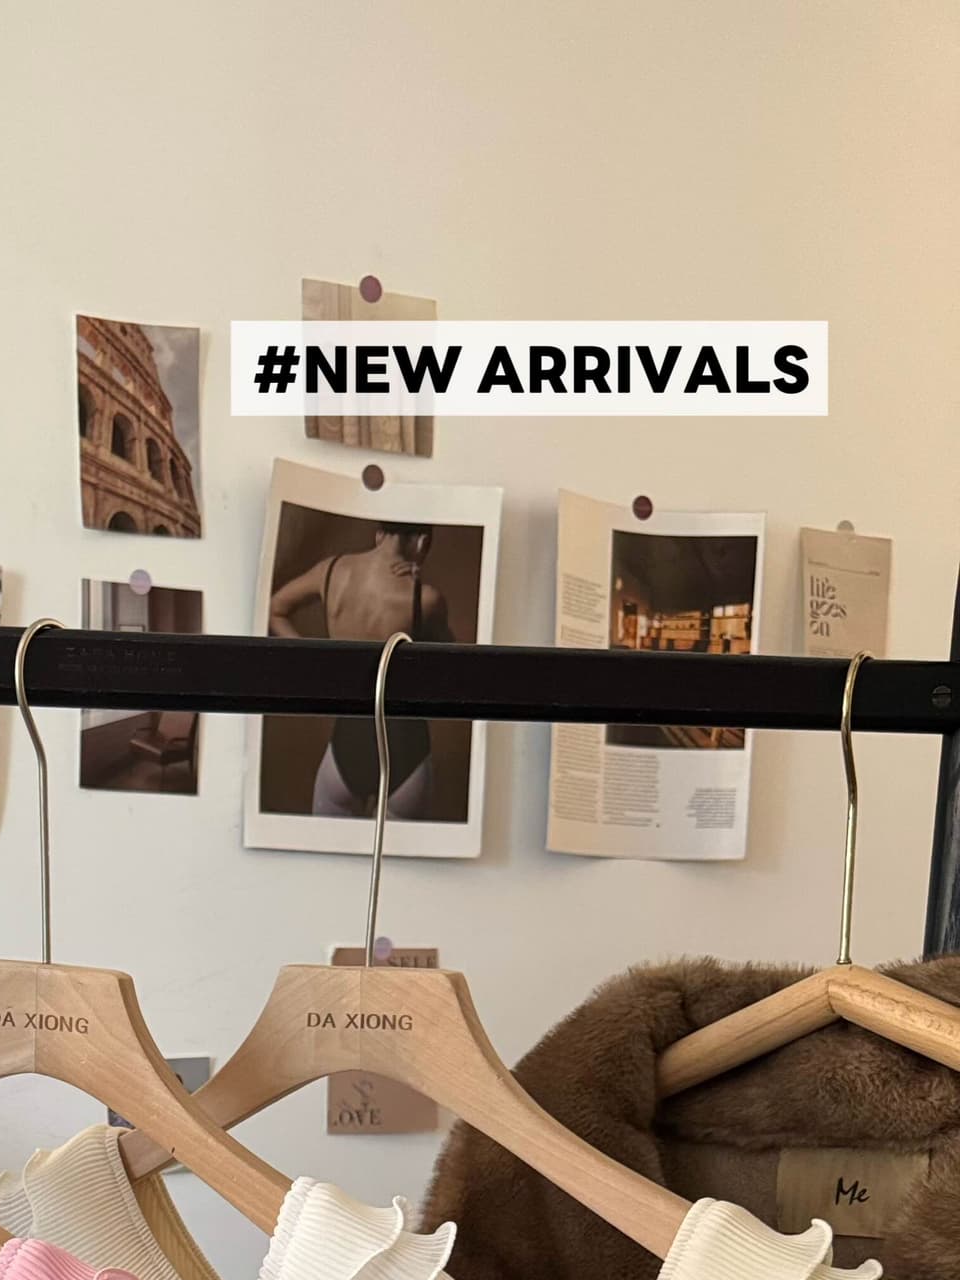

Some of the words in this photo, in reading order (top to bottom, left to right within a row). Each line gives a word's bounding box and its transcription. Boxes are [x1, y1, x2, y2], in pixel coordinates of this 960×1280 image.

[24, 1012, 90, 1035] XIONG
[306, 1012, 336, 1029] DA
[345, 1013, 414, 1032] XIONG
[334, 1108, 382, 1126] OVE
[834, 1177, 871, 1206] Me
